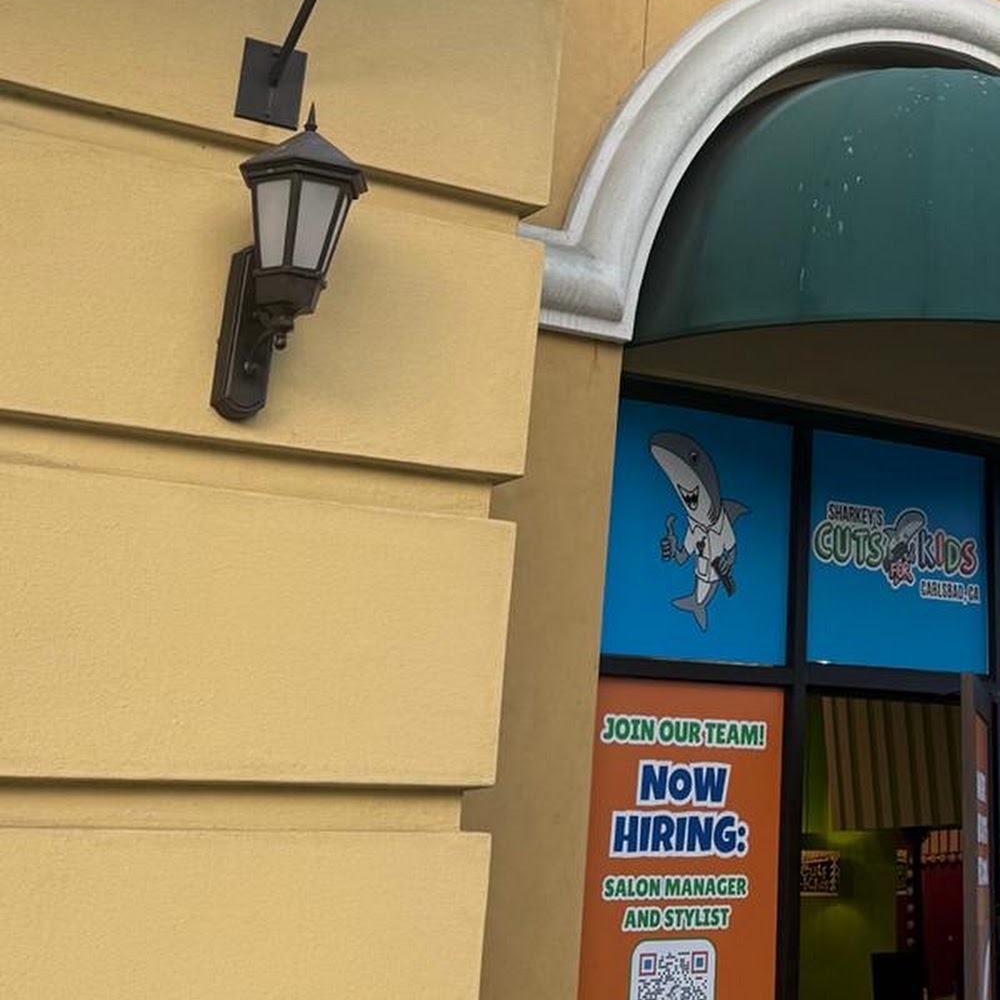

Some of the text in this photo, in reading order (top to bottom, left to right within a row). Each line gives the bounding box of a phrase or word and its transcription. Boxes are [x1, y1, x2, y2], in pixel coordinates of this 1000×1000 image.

[828, 503, 884, 527] SHARKEY'S
[814, 522, 979, 584] CUTS FOR KIDS
[603, 716, 766, 747] JOIN OUR TEAM!
[639, 763, 728, 804] NOW
[612, 813, 747, 855] HIRING:
[604, 876, 747, 898] SALON MANAGER
[624, 906, 730, 930] AND STYLIST
